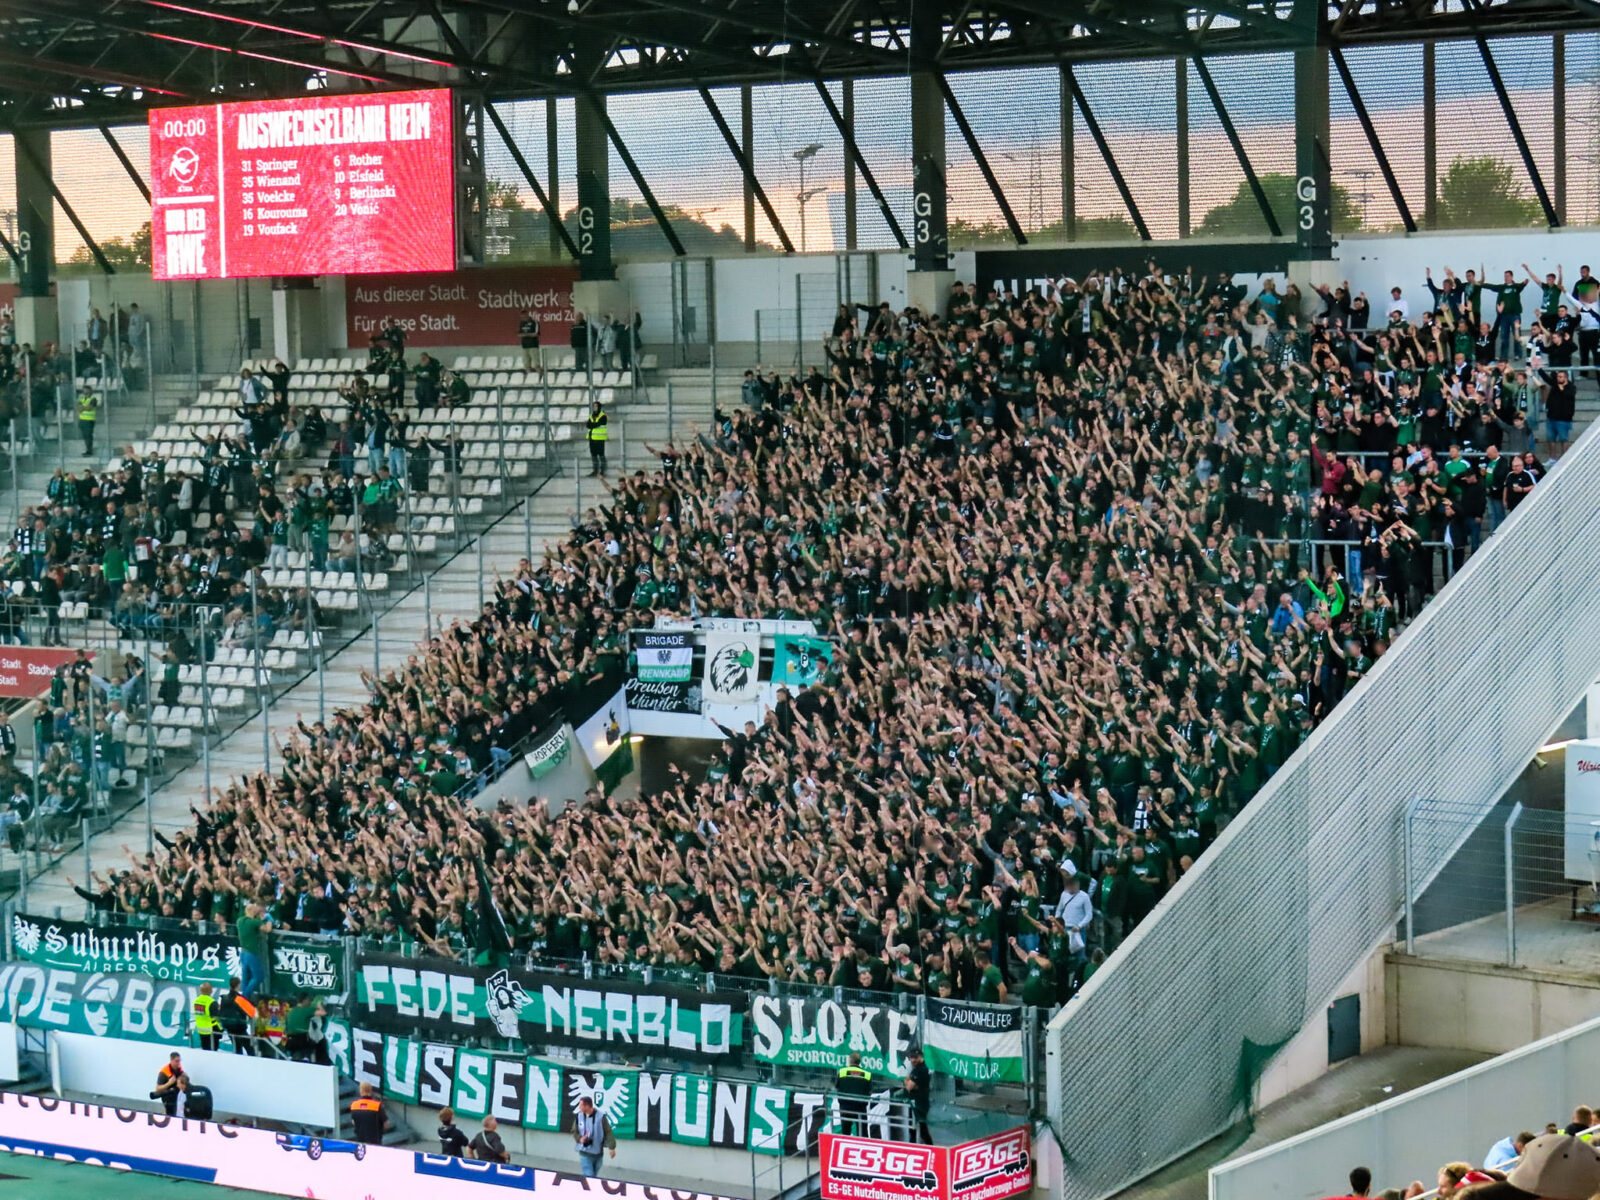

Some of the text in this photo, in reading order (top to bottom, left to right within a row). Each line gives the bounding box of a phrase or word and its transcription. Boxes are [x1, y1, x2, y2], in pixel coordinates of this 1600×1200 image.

[164, 119, 206, 138] 00:00
[238, 102, 430, 149] AUSWECHSELBANK HEIM
[241, 158, 298, 173] 31 Springer
[333, 153, 383, 167] 6 Rother
[256, 173, 301, 188] Wienand
[335, 169, 384, 183] 10 Eisfeld
[257, 190, 295, 203] Voelcke
[334, 185, 396, 200] 9 Berlinski
[1296, 176, 1316, 201] G
[243, 207, 308, 220] 16 Kourouma
[335, 203, 347, 216] 20
[914, 192, 932, 243] G 3
[243, 222, 298, 236] 19 Voufack
[579, 207, 594, 254] G 2
[166, 232, 207, 275] RWE
[354, 284, 469, 302] Aus dieser Stadt.
[354, 314, 460, 331] Für dese Stadt.
[645, 635, 684, 645] BRIGADE
[45, 925, 220, 971] Suburbboys
[293, 972, 337, 989] CREW
[362, 965, 475, 1025] FEDE
[941, 1006, 1013, 1029] STADIONHELFER
[857, 1055, 884, 1073] 906
[973, 1062, 1001, 1081] TOUR
[828, 1183, 852, 1195] ES-GE
